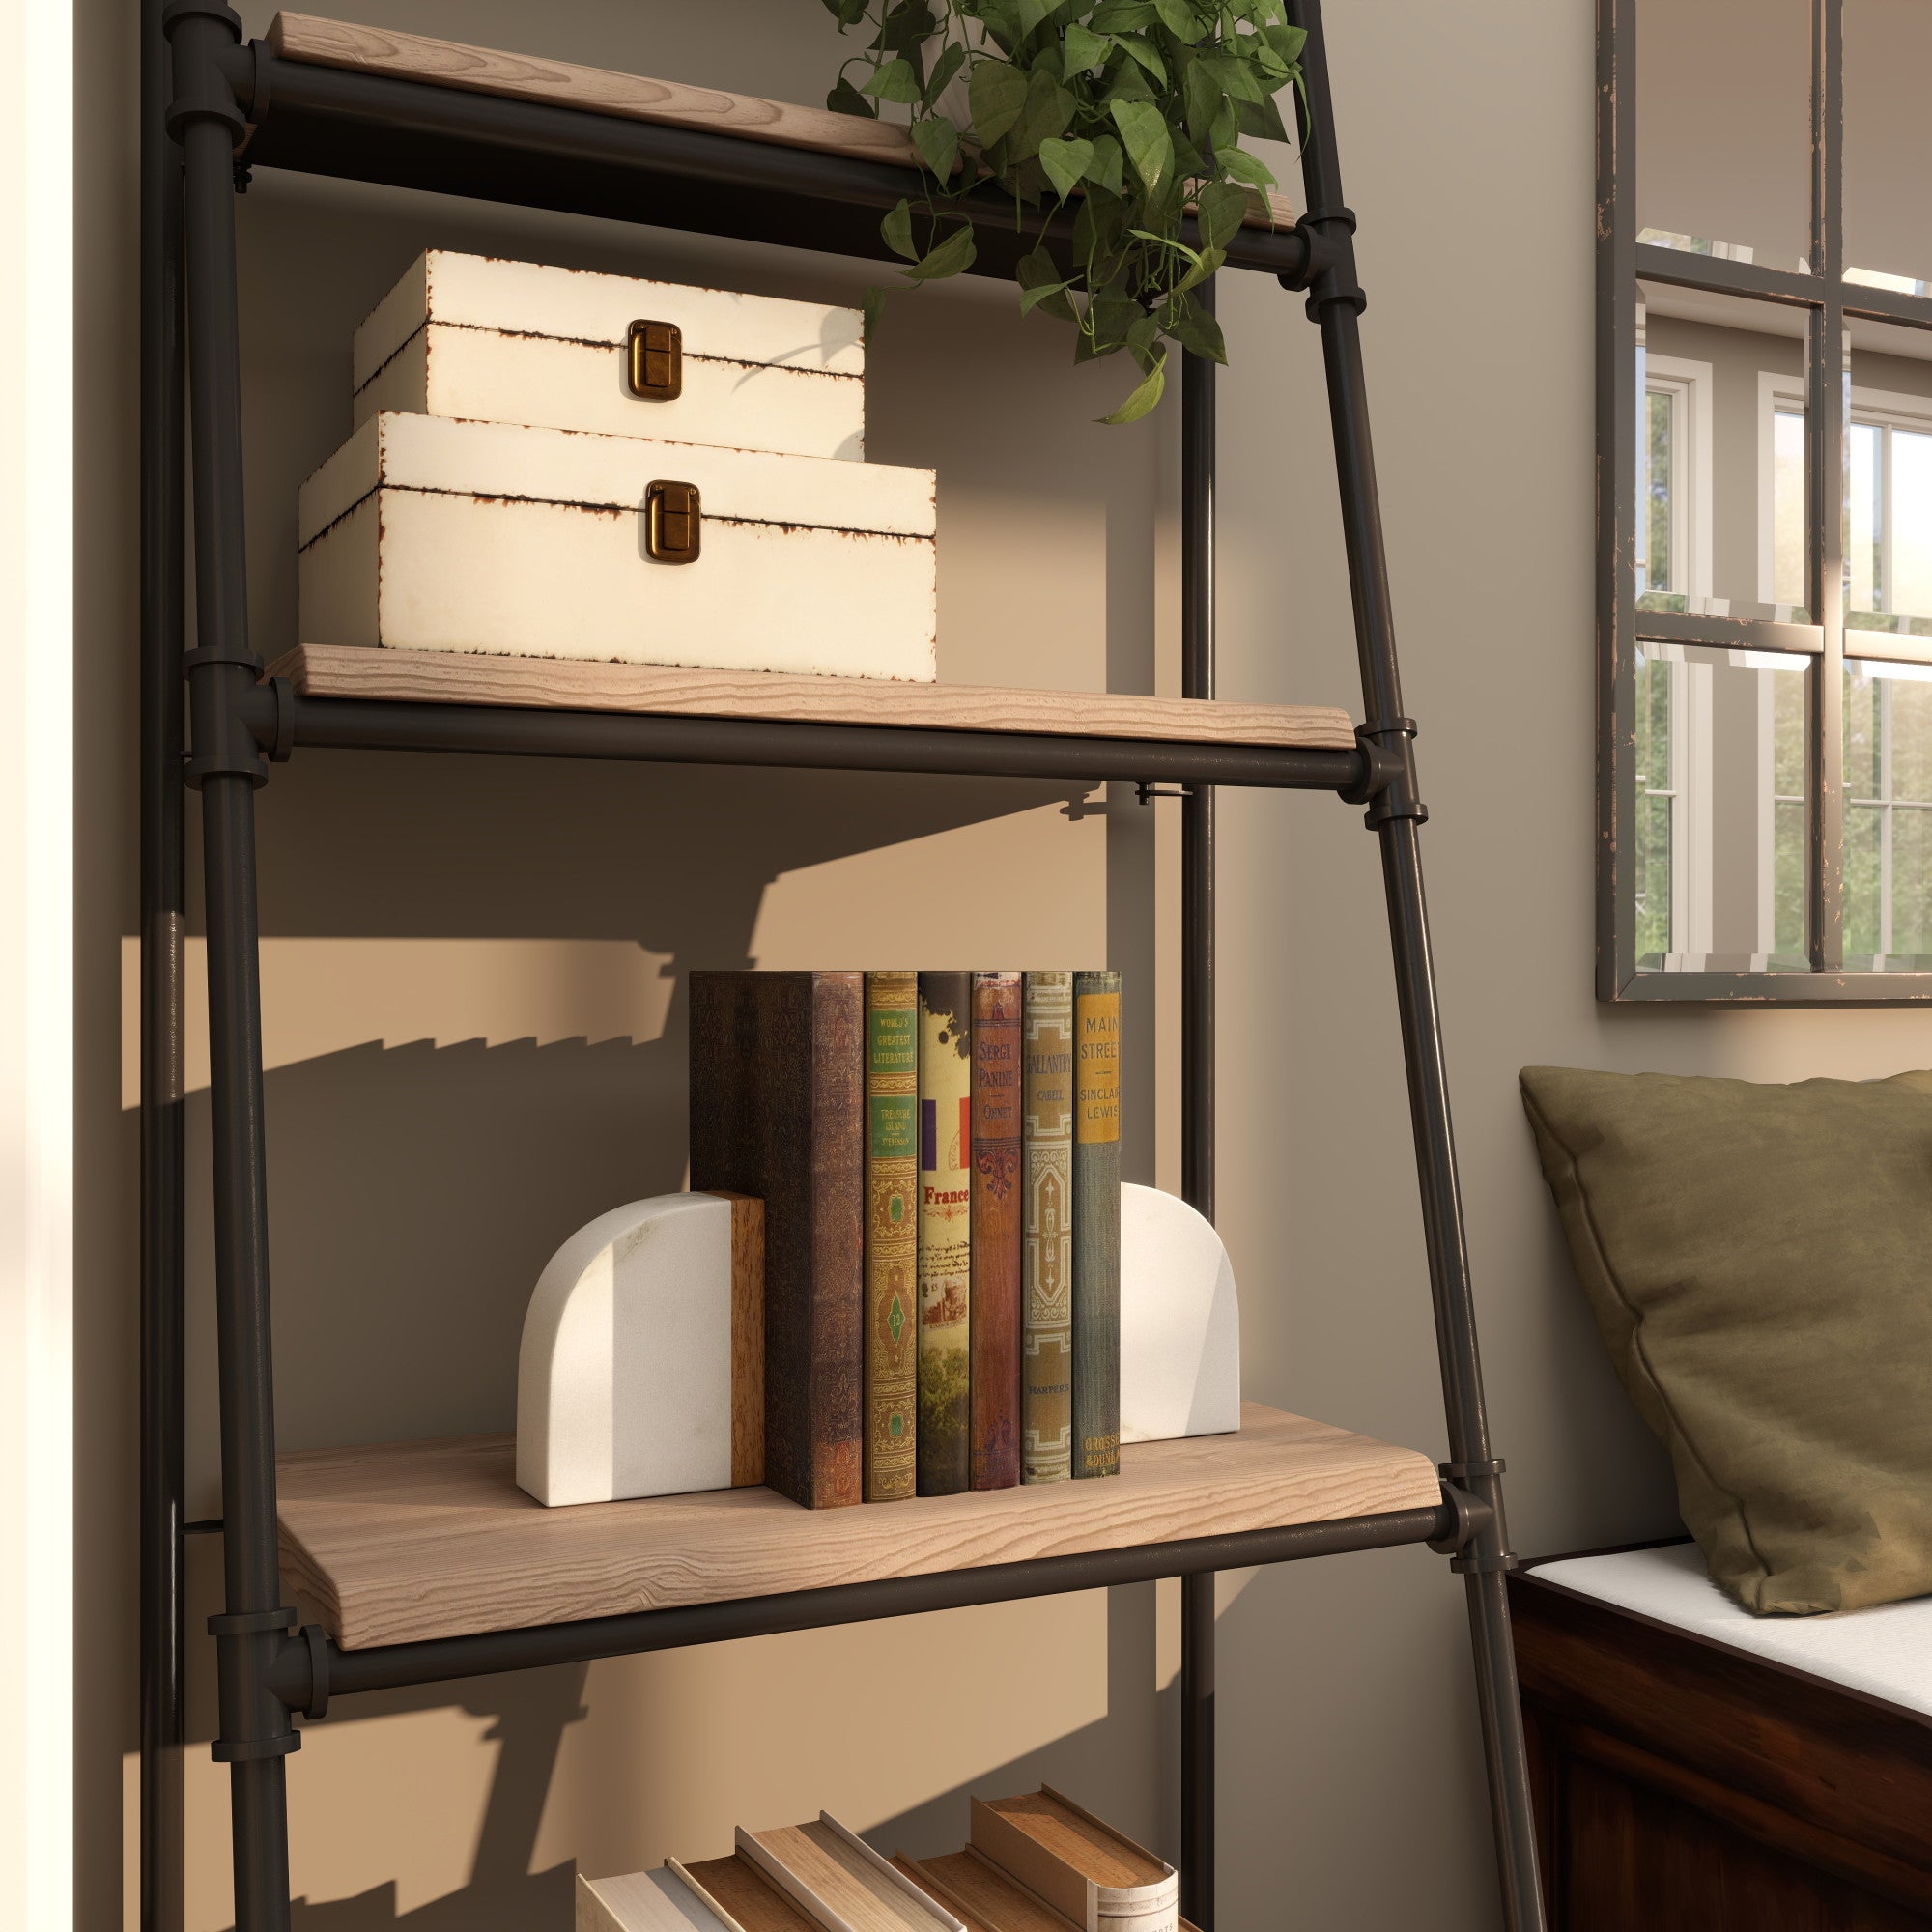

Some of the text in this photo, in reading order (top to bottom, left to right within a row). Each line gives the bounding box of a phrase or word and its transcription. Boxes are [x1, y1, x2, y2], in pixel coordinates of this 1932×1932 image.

[880, 1016, 909, 1028] WORLD'S
[1086, 1016, 1120, 1034] MAIN
[877, 1035, 911, 1046] GREATEST
[980, 1041, 1011, 1061] SERGE
[1081, 1041, 1121, 1060] STREE
[873, 1052, 914, 1064] LITERATURE
[978, 1067, 1013, 1087] PANINE
[1037, 1089, 1065, 1101] CABELL
[881, 1108, 911, 1120] TREASURE
[1087, 1104, 1119, 1120] LEWIS
[885, 1122, 906, 1131] ISLAND
[882, 1137, 909, 1147] STEVENSON
[923, 1186, 970, 1205] France
[892, 1314, 901, 1327] 12
[1028, 1383, 1069, 1395] HARPERS
